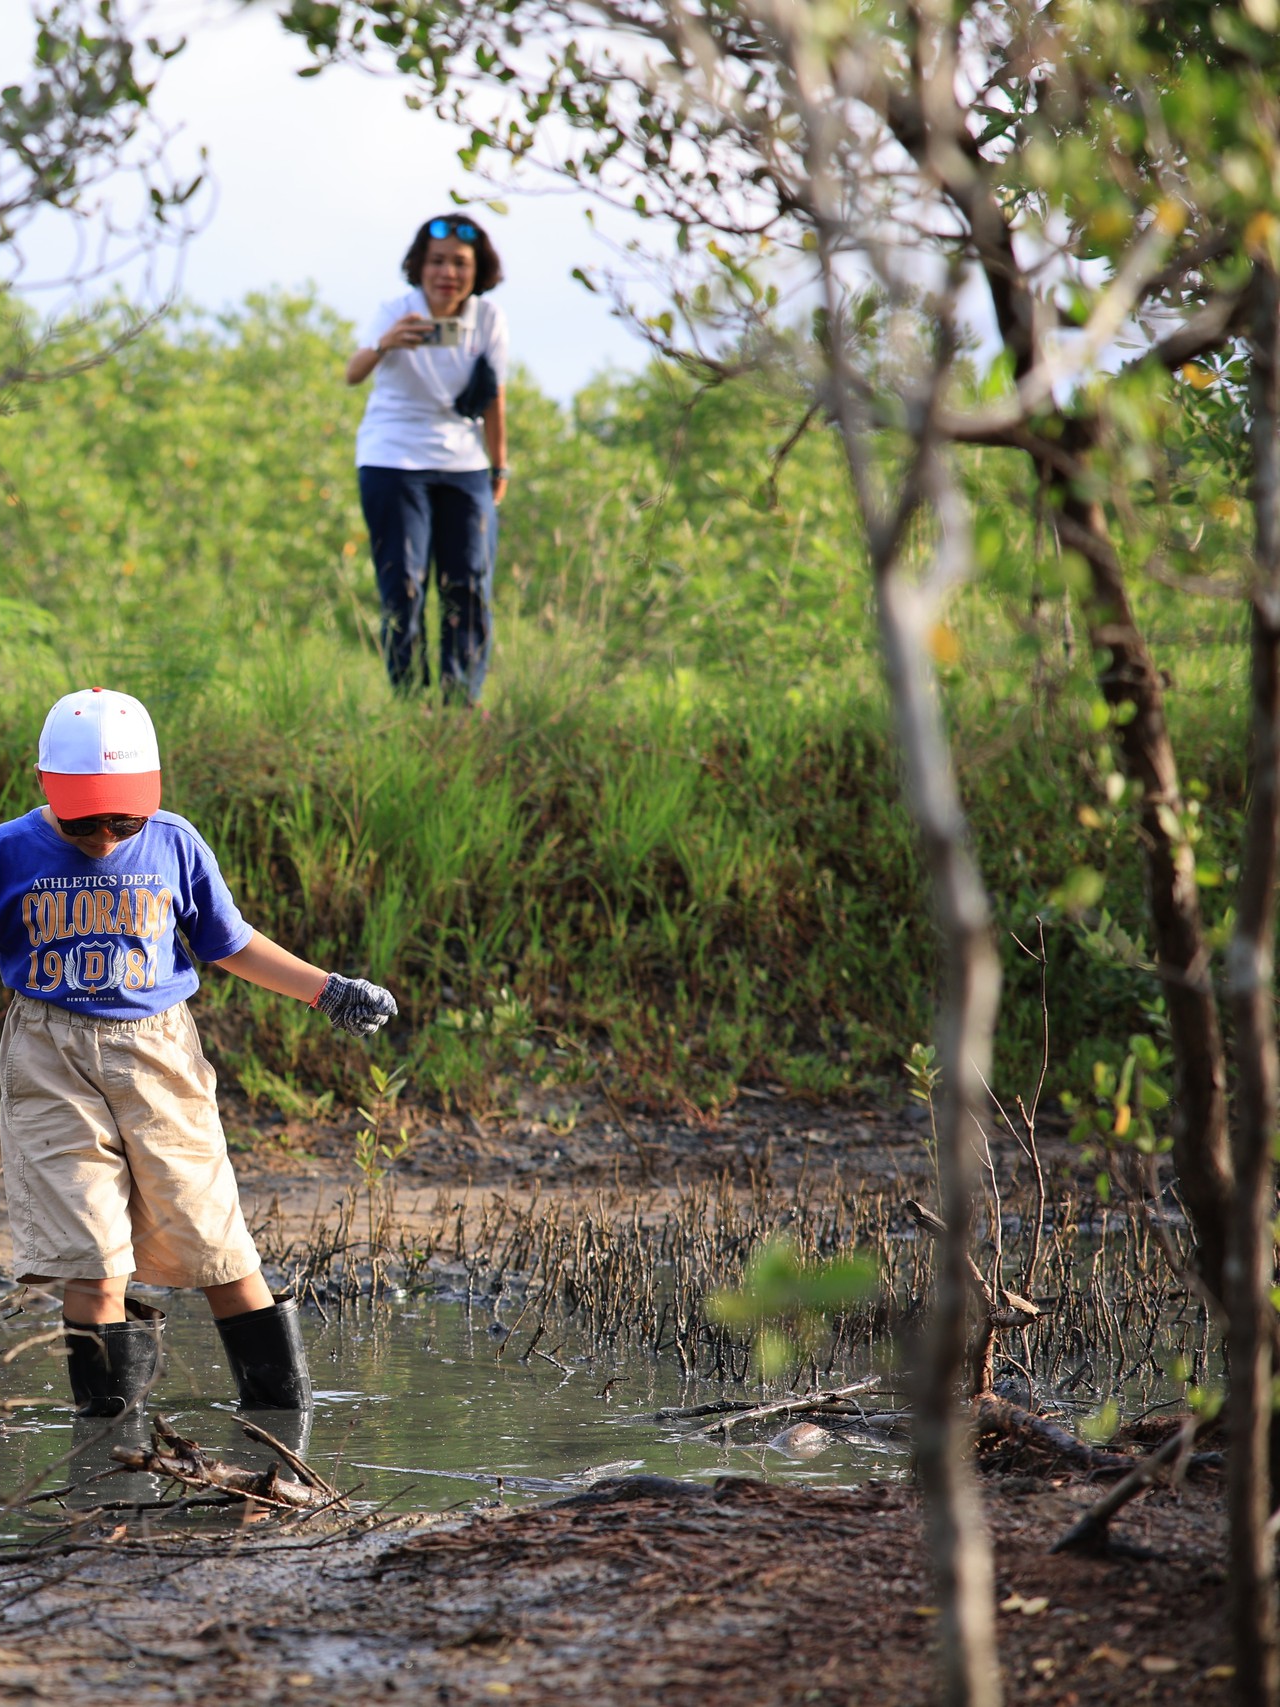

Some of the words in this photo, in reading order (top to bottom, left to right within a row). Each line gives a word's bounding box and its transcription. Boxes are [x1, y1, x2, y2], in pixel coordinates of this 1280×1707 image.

[104, 751, 138, 760] HDBank
[32, 875, 117, 890] ATHLETICS
[121, 873, 162, 887] DEPT.
[22, 888, 172, 947] COLORADO
[26, 949, 63, 992] 19
[83, 951, 105, 981] D
[124, 944, 159, 991] 87
